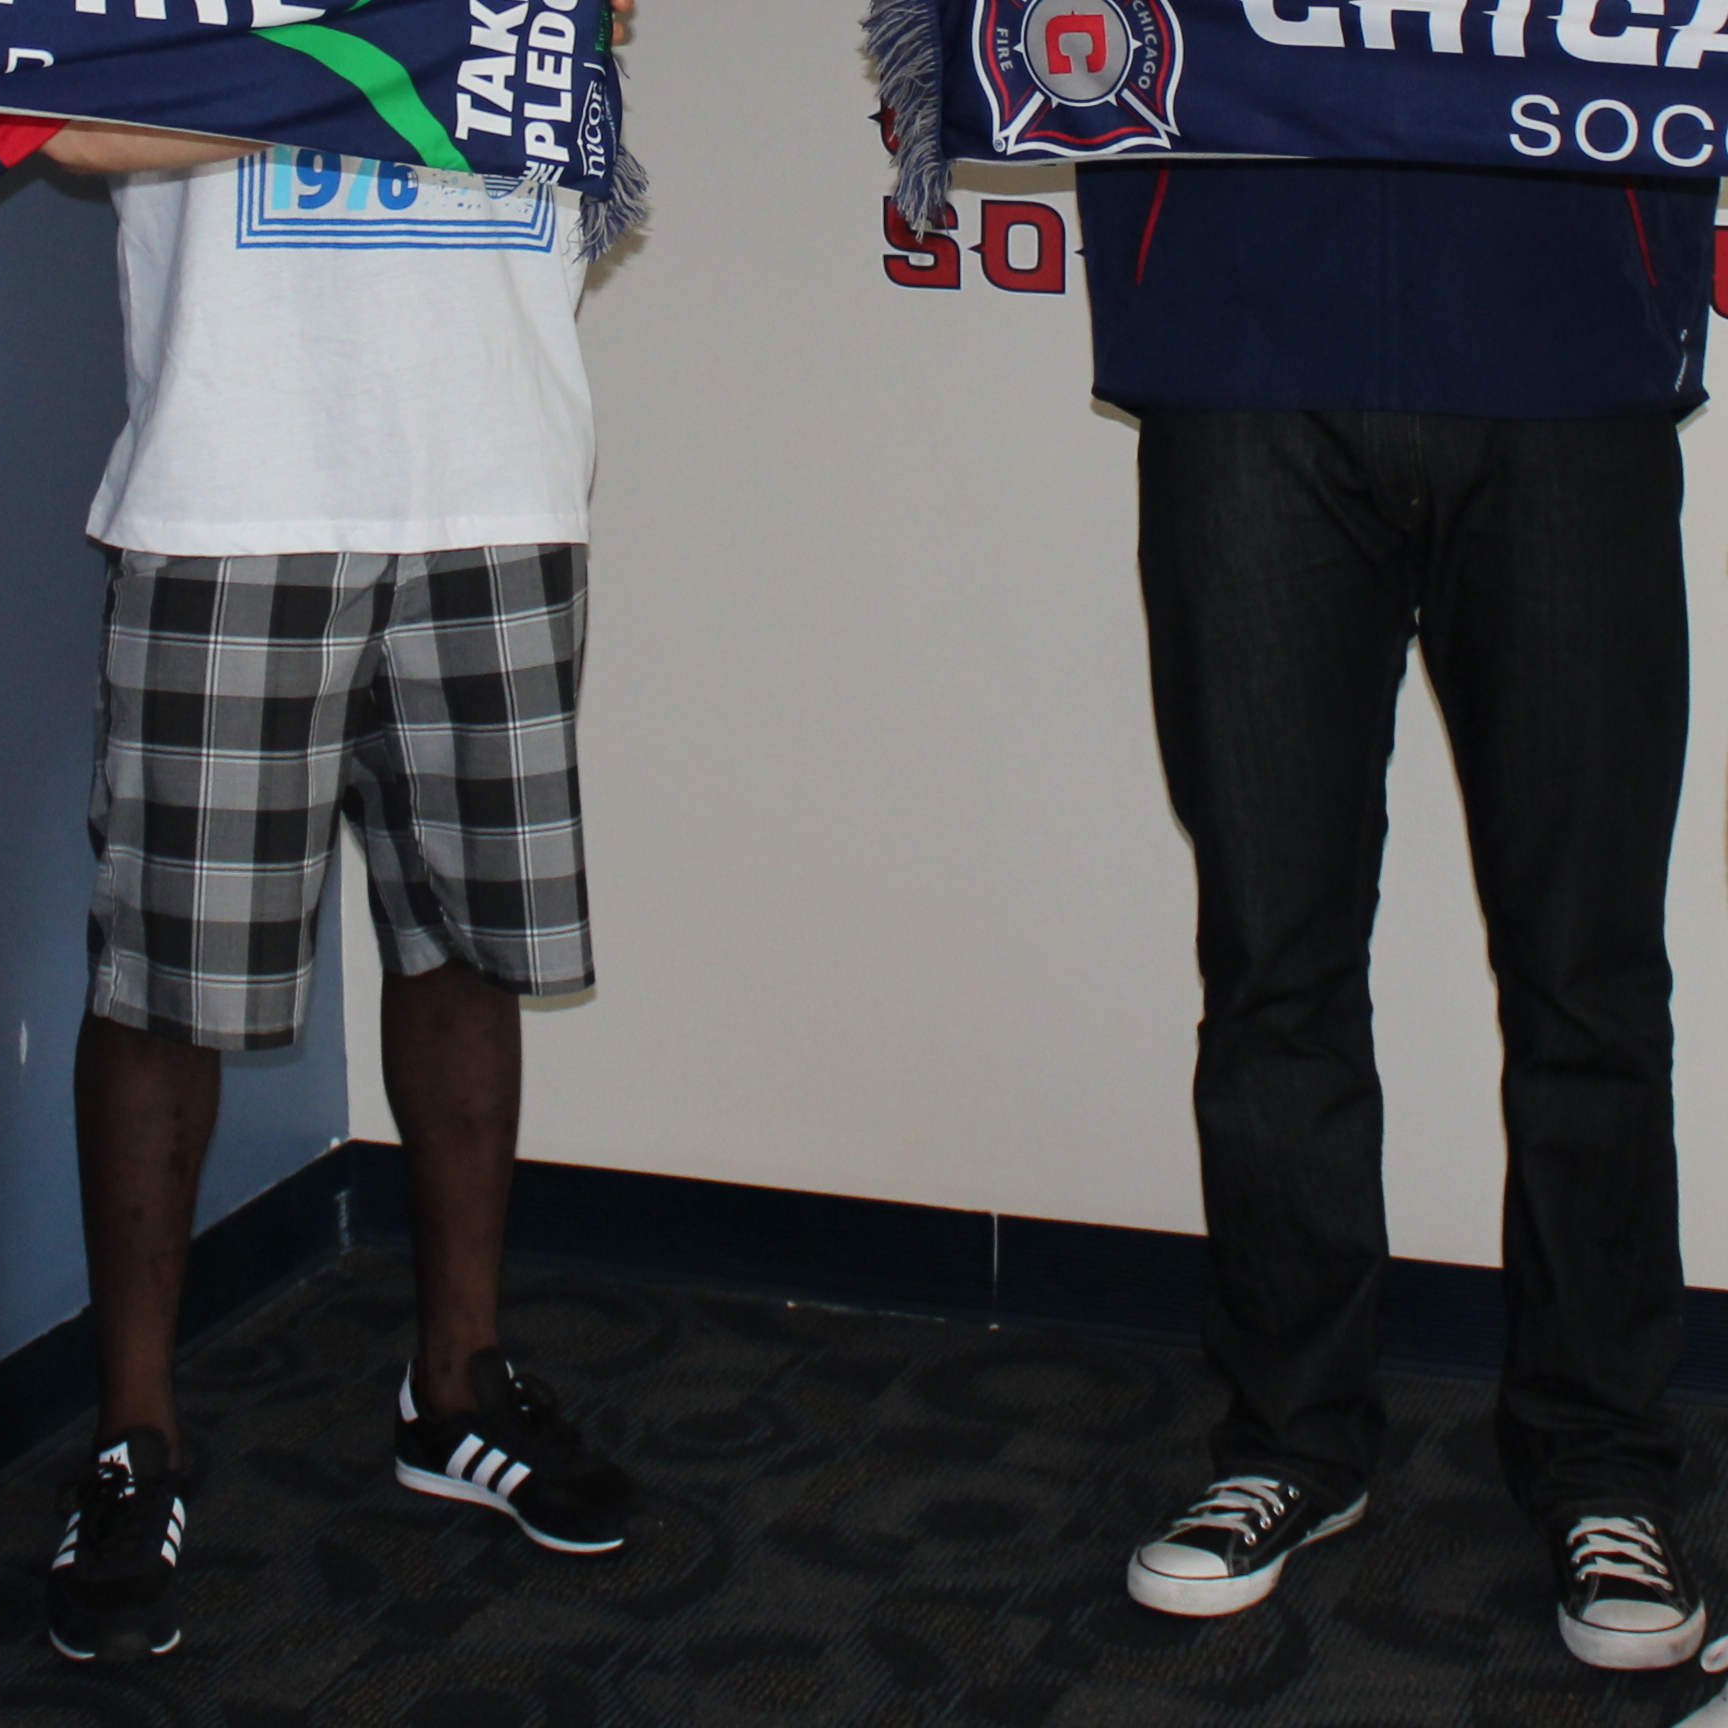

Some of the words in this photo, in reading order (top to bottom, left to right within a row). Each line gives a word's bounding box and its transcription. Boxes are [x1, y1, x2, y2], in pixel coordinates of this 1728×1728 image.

[997, 27, 1013, 72] FIRE
[1132, 0, 1158, 90] CHICAGO
[585, 82, 606, 179] nicor
[272, 145, 419, 210] 1976
